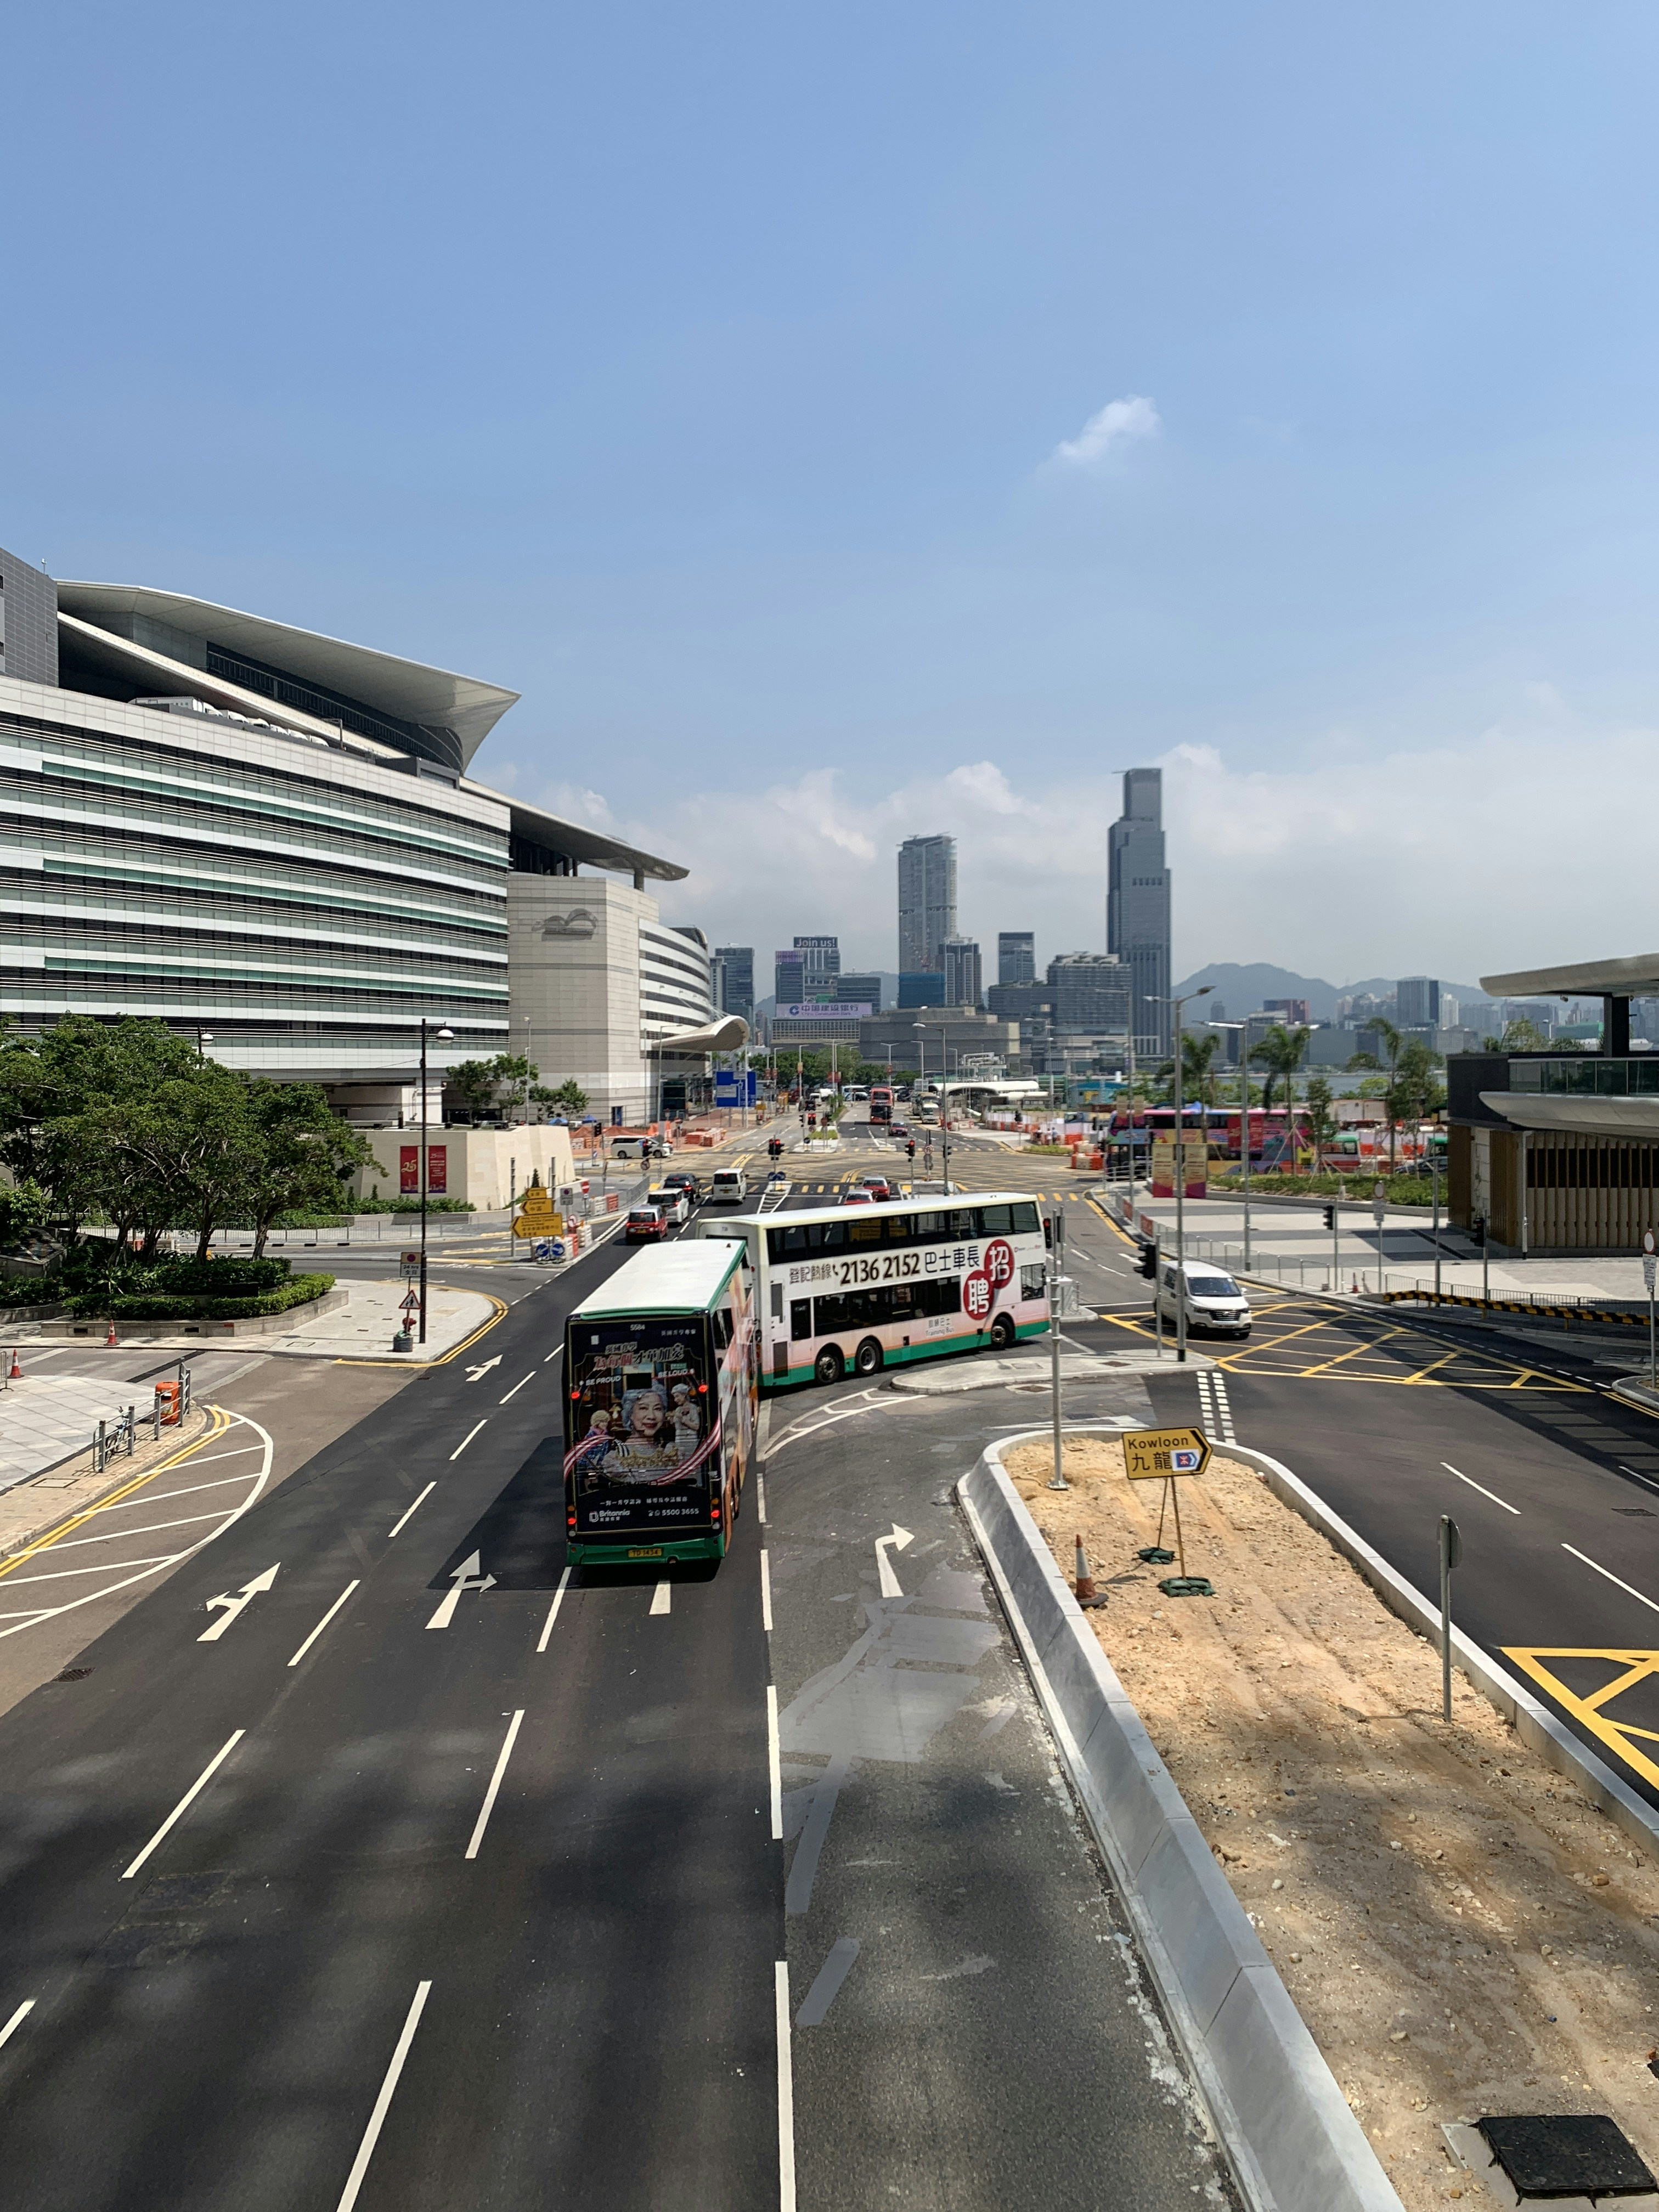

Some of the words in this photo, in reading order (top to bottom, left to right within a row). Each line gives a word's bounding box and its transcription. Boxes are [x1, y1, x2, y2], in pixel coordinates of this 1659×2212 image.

[797, 938, 818, 947] Join
[820, 938, 835, 947] us!
[401, 1159, 417, 1172] 25
[789, 1263, 832, 1284] 登記熱線
[840, 1259, 879, 1286] 2136
[883, 1253, 920, 1280] 2152
[925, 1245, 980, 1273] 巴士車長
[989, 1245, 1011, 1282] 招
[967, 1277, 990, 1315] 聘
[926, 1327, 945, 1336] Training
[596, 1375, 622, 1385] PROUD
[1128, 1437, 1188, 1449] Kowloon
[1132, 1451, 1172, 1471] 九龍
[599, 1509, 630, 1517] Britannia
